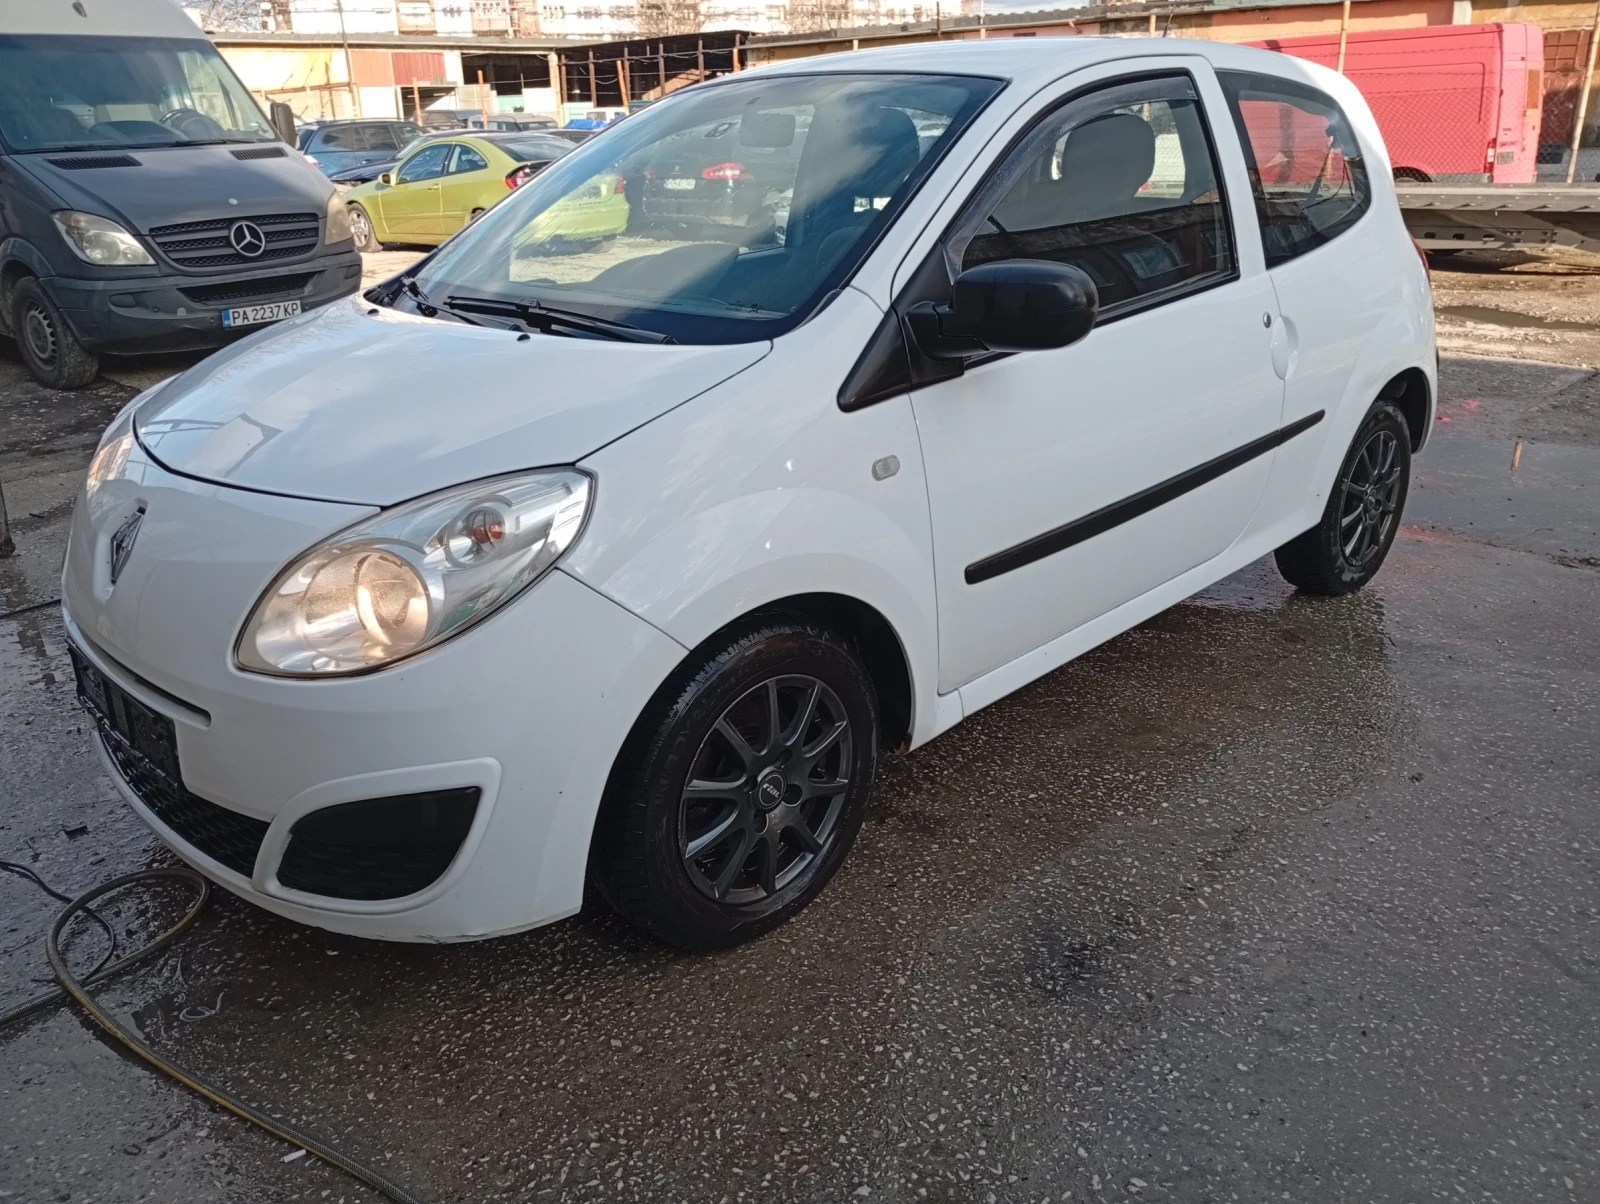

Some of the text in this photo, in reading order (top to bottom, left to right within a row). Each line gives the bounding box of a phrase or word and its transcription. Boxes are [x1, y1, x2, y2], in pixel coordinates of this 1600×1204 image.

[231, 302, 299, 324] PA 2237 KP
